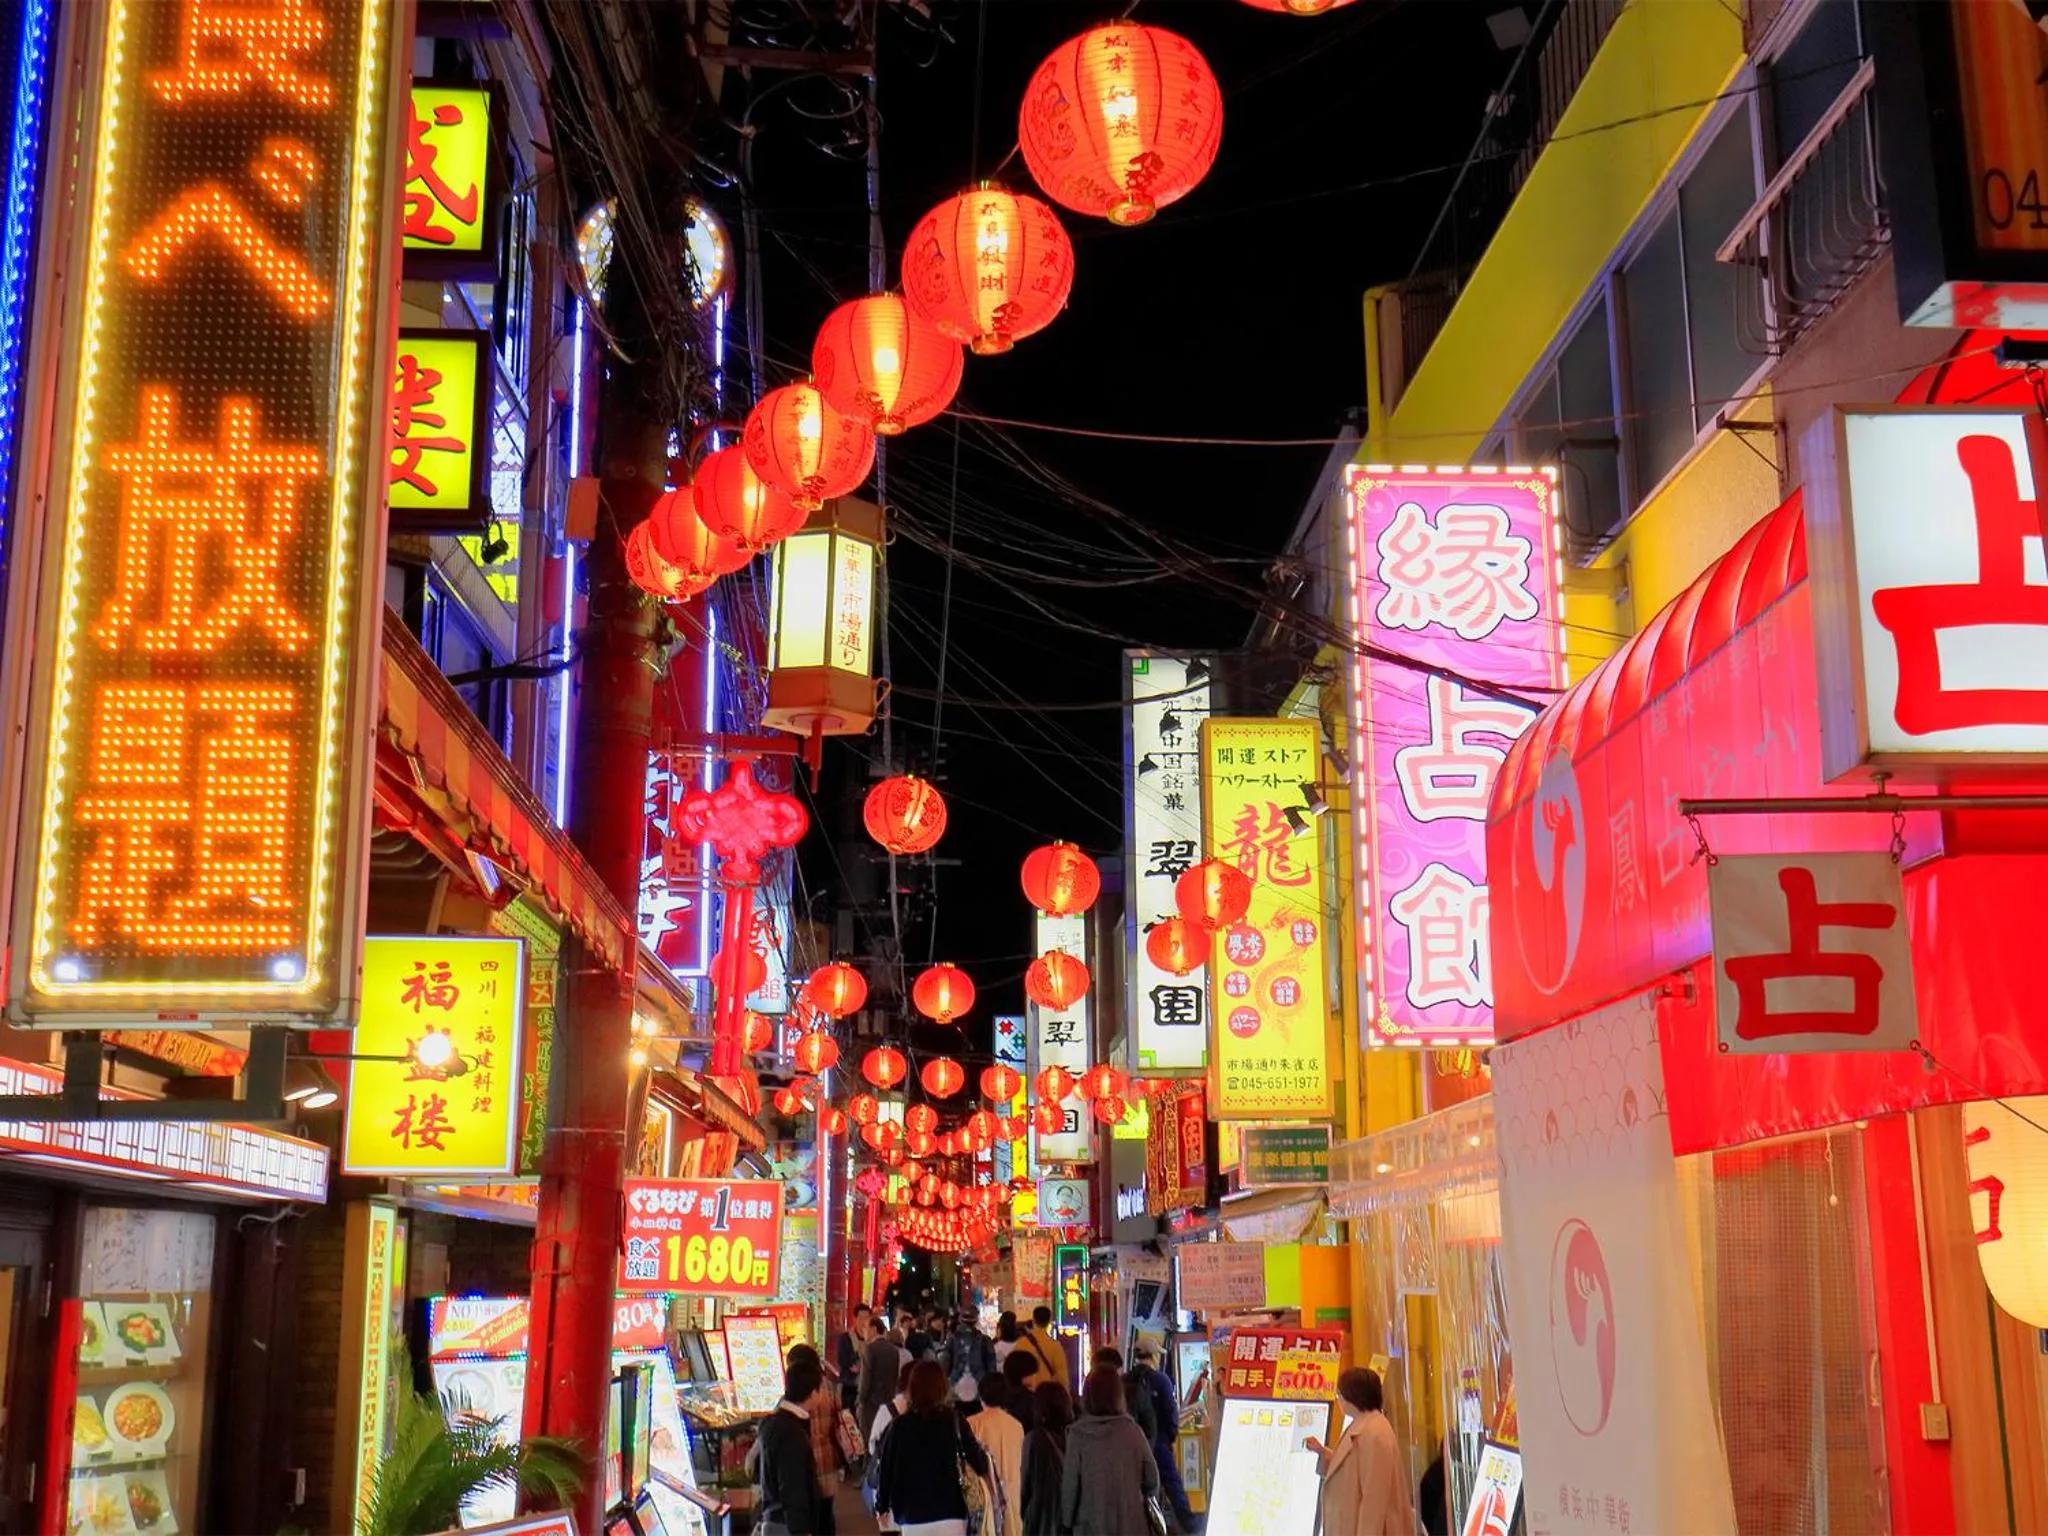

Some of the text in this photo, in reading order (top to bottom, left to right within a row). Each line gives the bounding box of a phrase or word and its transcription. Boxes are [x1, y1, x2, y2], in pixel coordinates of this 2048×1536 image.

[1161, 700, 1184, 811] 元中国銘菓
[1220, 800, 1311, 888] 龍
[1143, 839, 1204, 1026] 翠園
[1724, 866, 1896, 1041] 占
[1241, 1076, 1320, 1090] 045-651-1977
[629, 1184, 773, 1232] ぐるなび 第1位獲得
[626, 1257, 660, 1281] 放題
[627, 1236, 661, 1258] 食べ
[666, 1234, 770, 1287] 1680円
